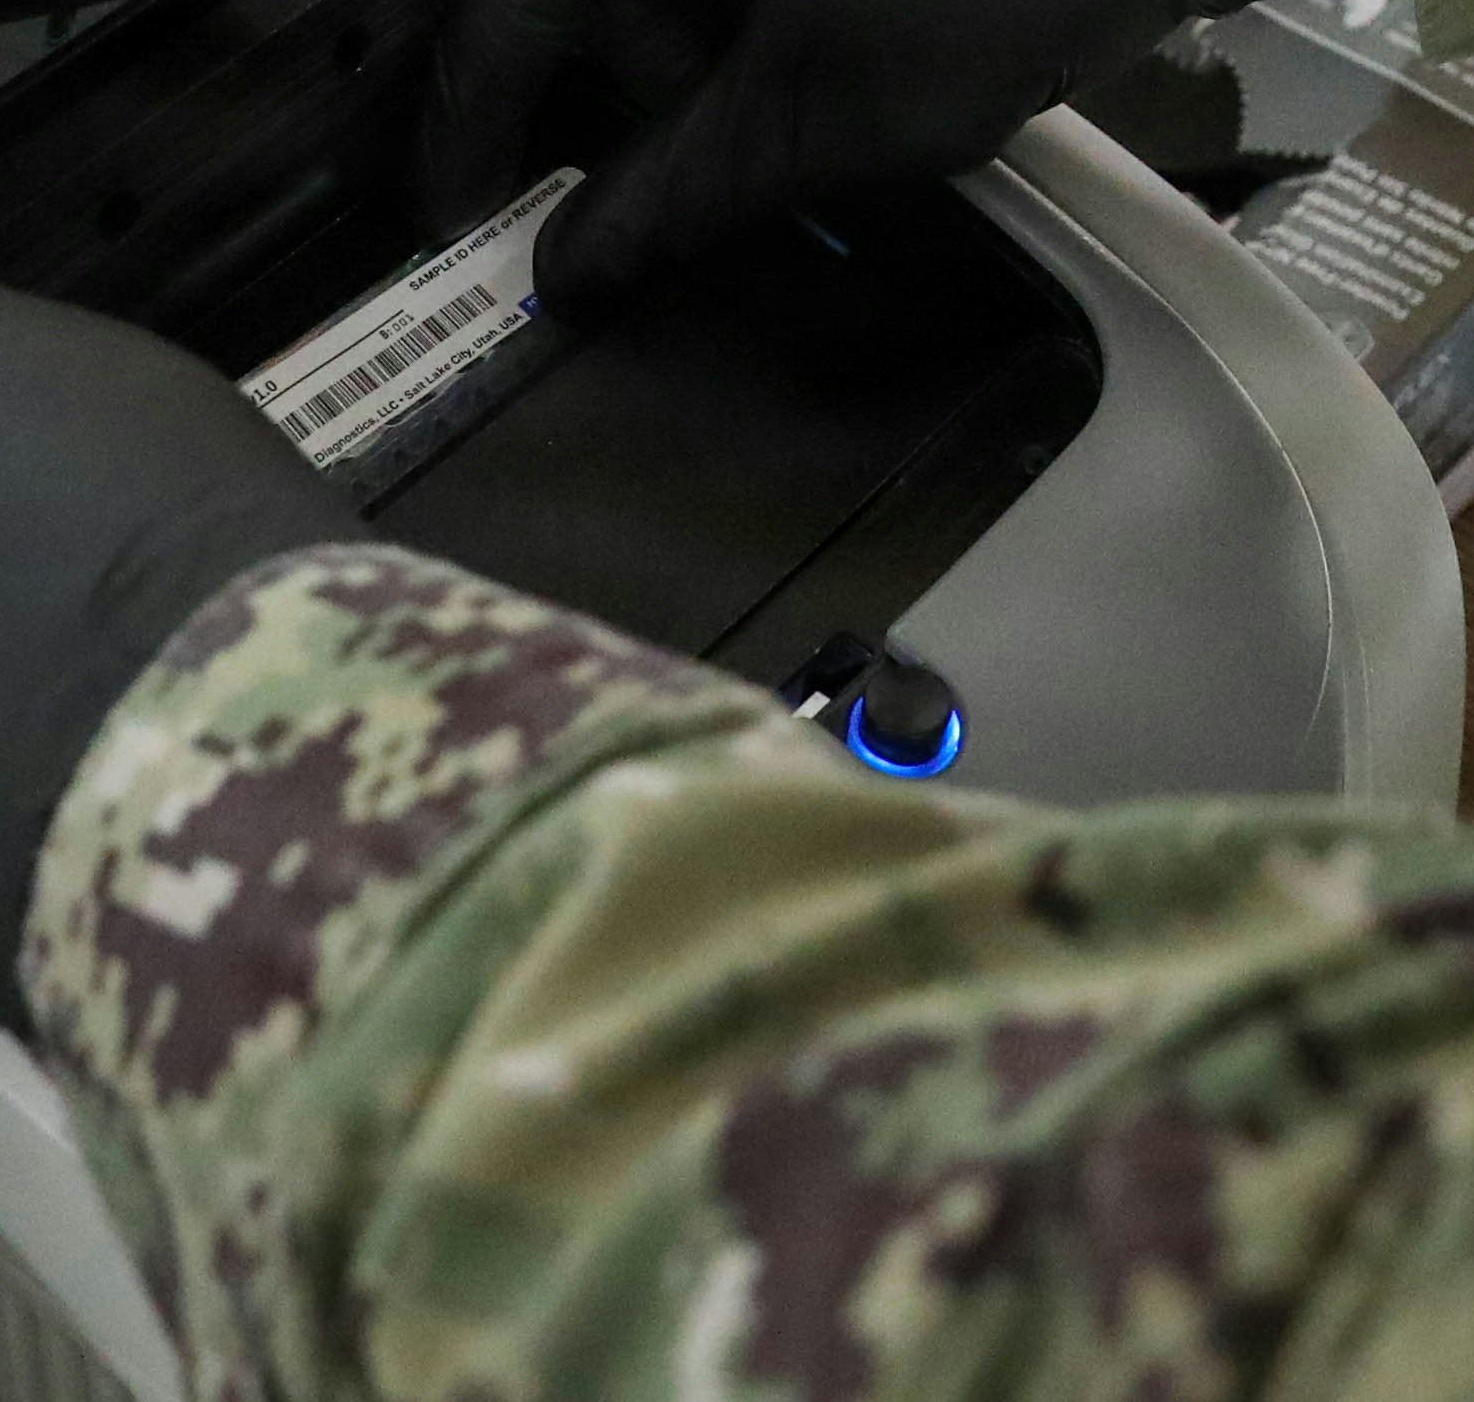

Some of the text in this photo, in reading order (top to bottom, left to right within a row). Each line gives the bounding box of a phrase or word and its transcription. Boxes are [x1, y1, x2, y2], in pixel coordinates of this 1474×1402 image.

[409, 177, 567, 290] SAMPLE ID HERE or REVERSE
[314, 313, 524, 463] Diagnostics, LLC Salt Lake City, Utah, USA
